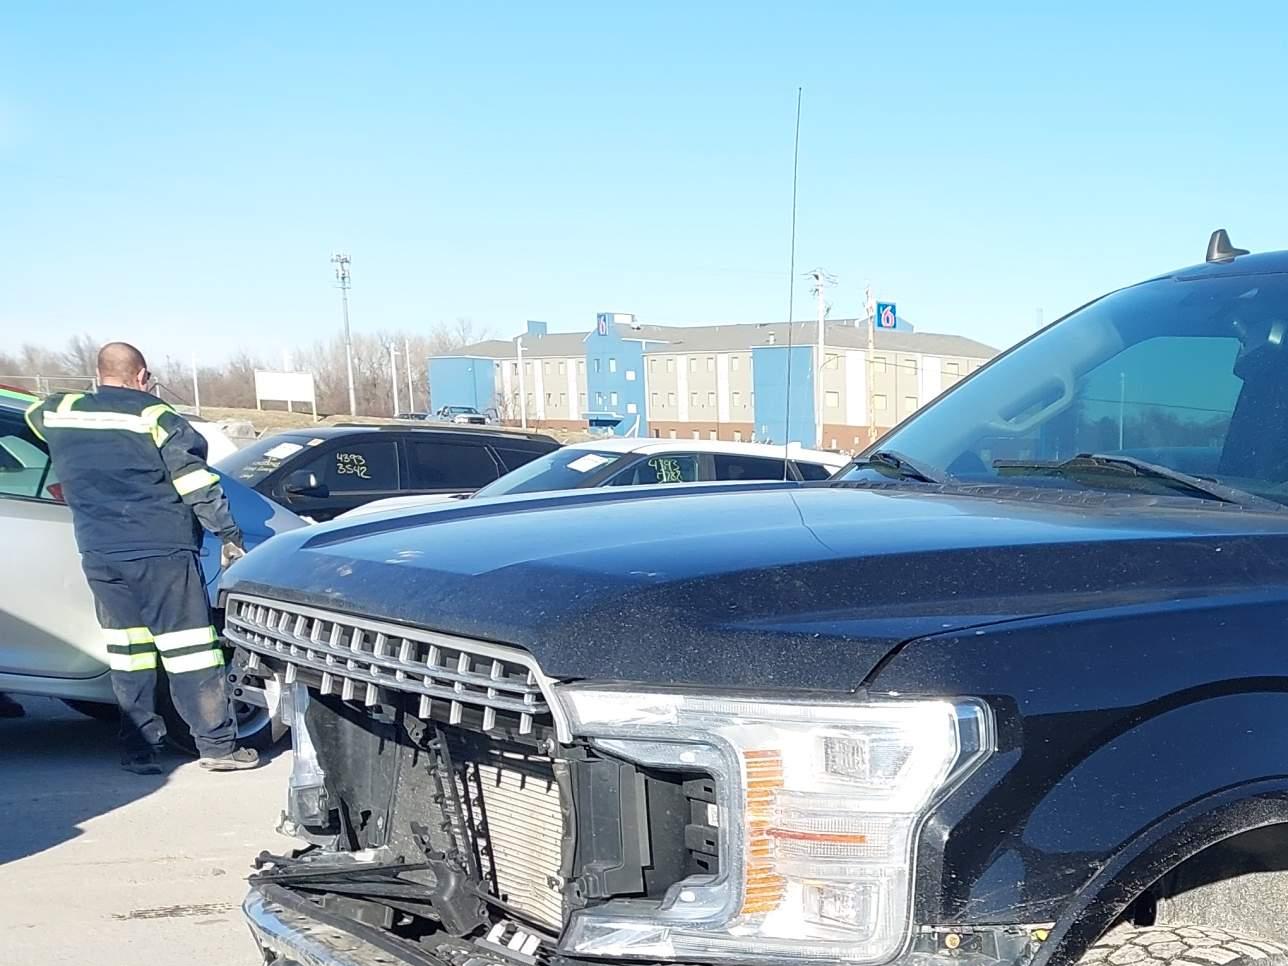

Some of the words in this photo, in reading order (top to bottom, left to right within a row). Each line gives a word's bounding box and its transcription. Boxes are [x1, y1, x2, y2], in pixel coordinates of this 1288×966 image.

[881, 305, 895, 328] 6
[336, 452, 366, 465] 4393
[336, 463, 372, 479] 3542
